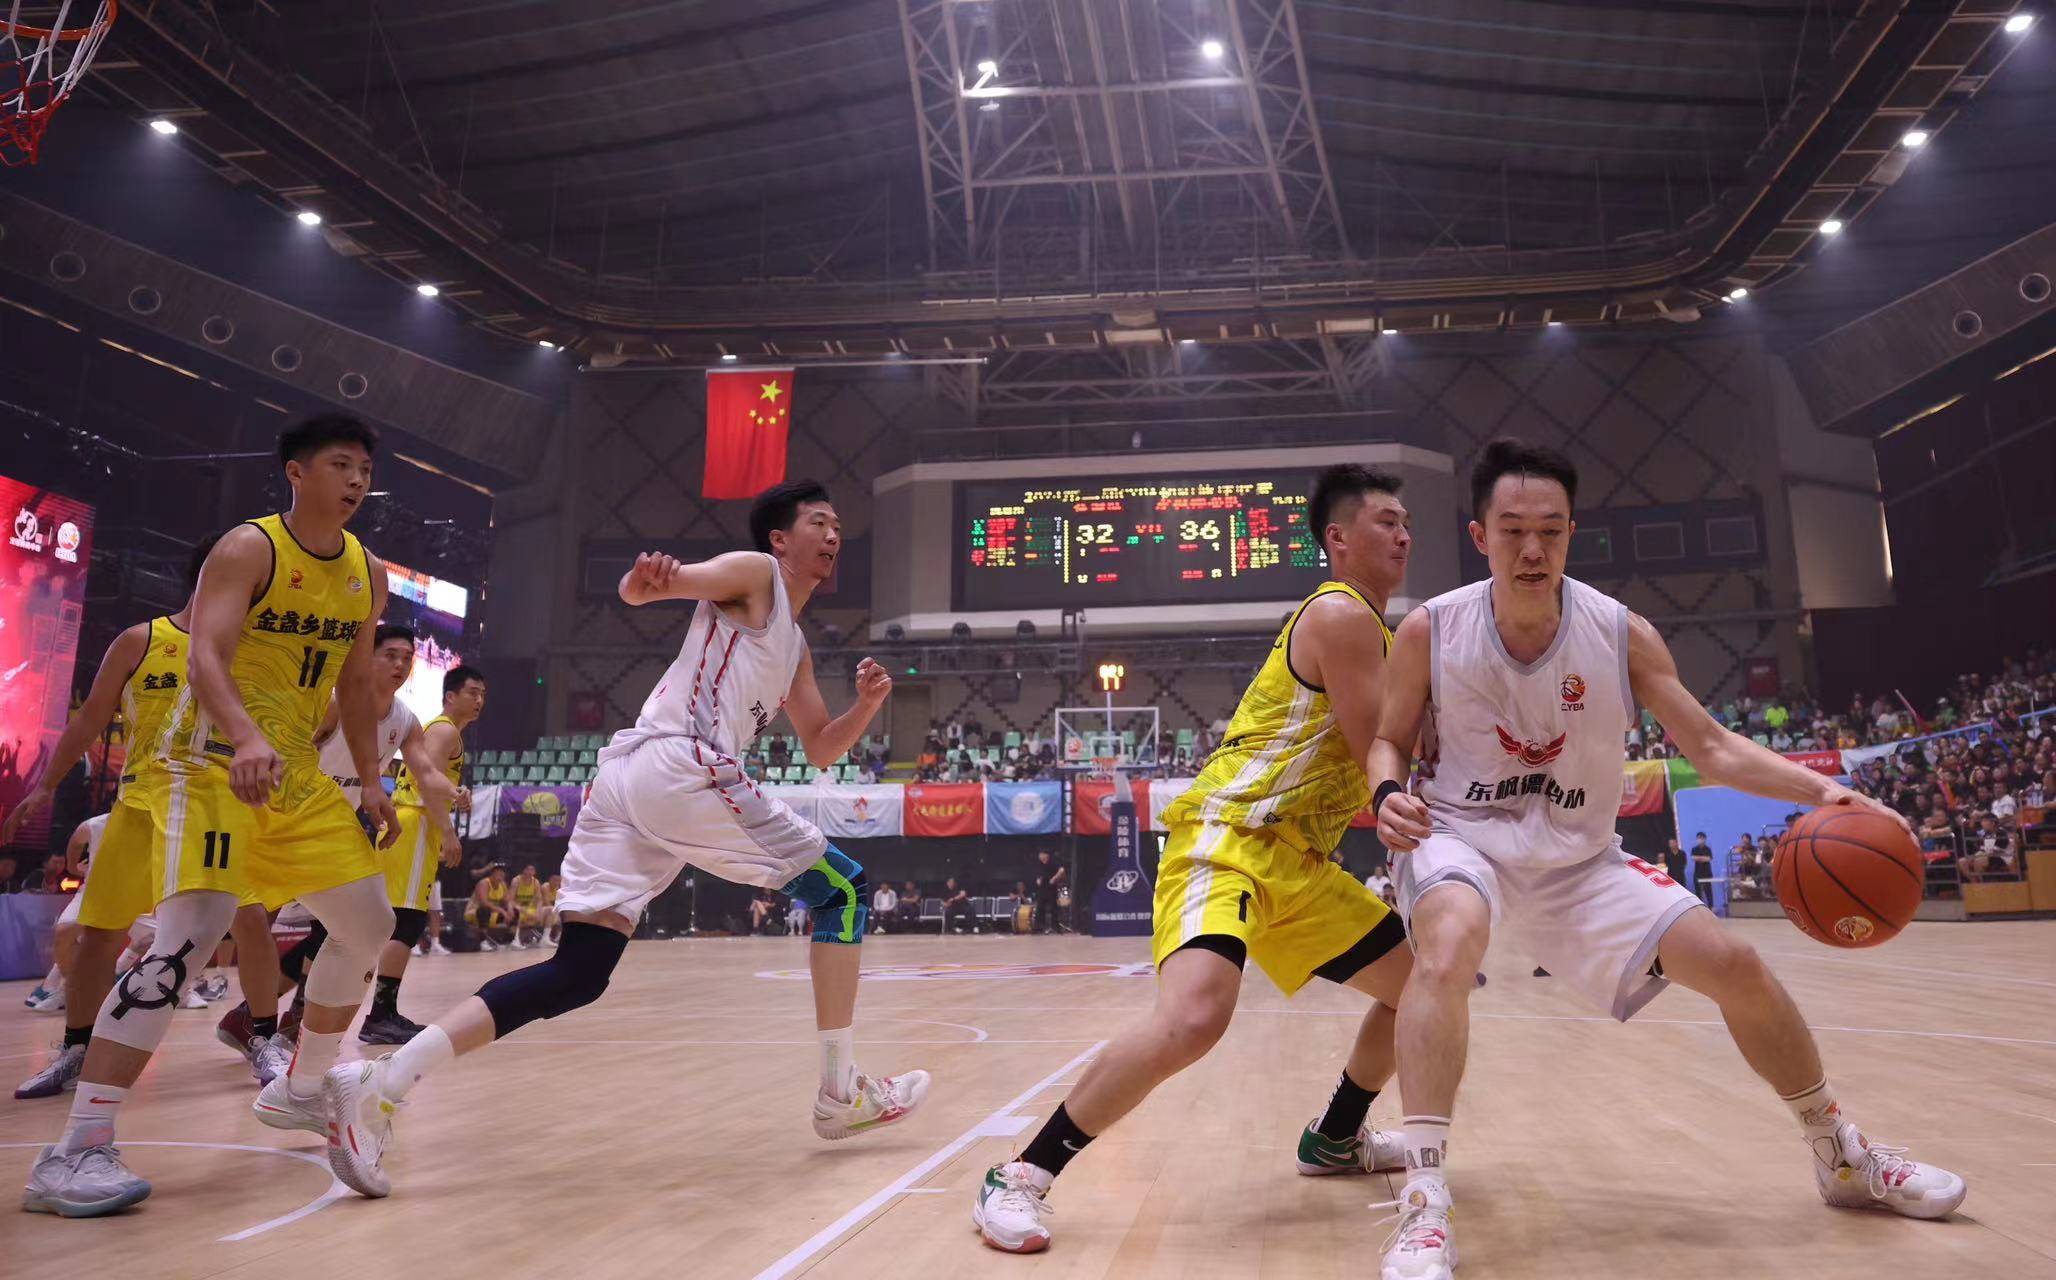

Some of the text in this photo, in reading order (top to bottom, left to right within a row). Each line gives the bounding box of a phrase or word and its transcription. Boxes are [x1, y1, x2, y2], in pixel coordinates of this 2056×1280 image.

[1076, 524, 1114, 544] 32
[1180, 520, 1220, 540] 36
[252, 607, 362, 641] 金盏乡篮球
[298, 645, 328, 688] 11
[1560, 703, 1585, 711] CYBA
[203, 831, 231, 869] 11
[1623, 857, 1677, 888] 5
